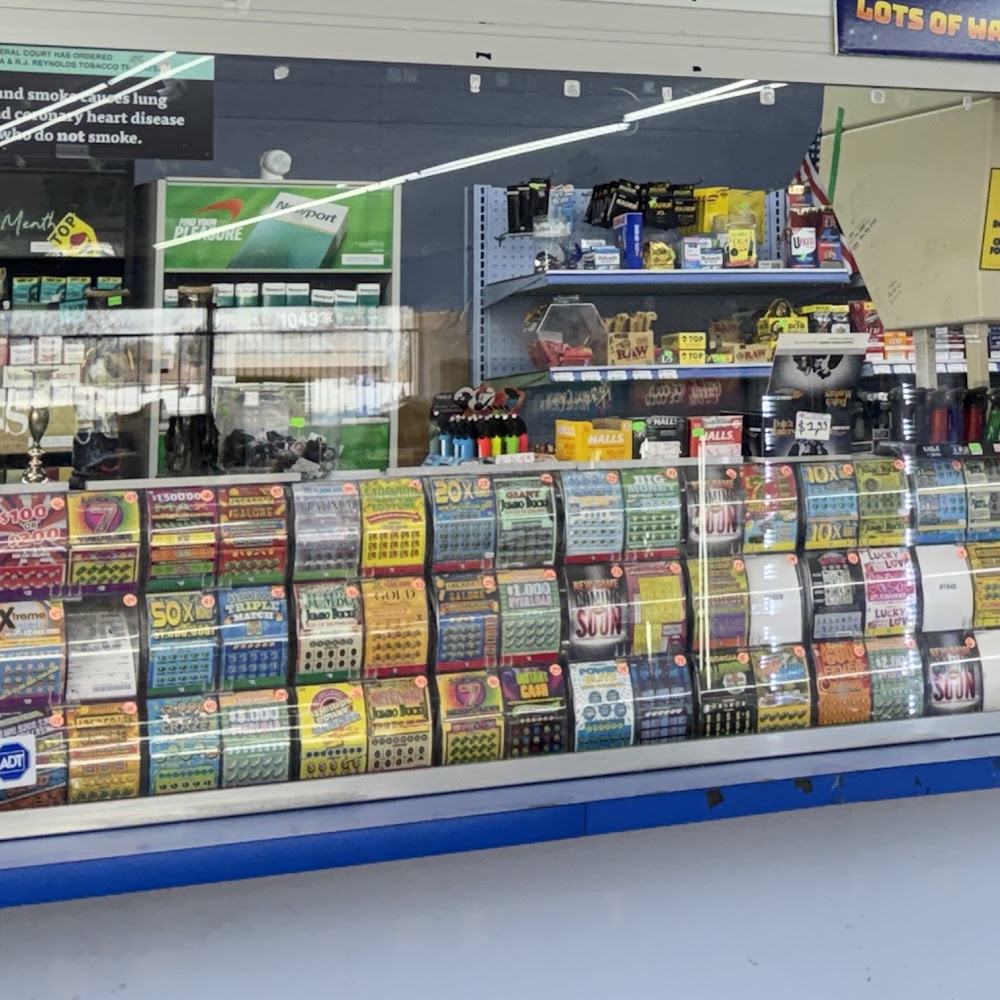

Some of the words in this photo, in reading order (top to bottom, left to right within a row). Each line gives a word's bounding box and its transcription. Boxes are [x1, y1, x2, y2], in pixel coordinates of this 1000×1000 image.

[929, 11, 963, 37] OF
[23, 49, 51, 58] COURT
[54, 51, 72, 59] HAS
[74, 52, 113, 61] ORDERED
[32, 59, 77, 68] REYNOLDS
[79, 61, 118, 70] TOBACCO
[133, 92, 168, 110] lung
[87, 110, 128, 124] heart
[131, 112, 185, 126] disease
[34, 128, 54, 141] do
[57, 130, 85, 142] not
[88, 130, 143, 145] smoke.
[50, 213, 77, 245] TOP
[197, 217, 217, 226] YOUR
[617, 345, 648, 360] RAW
[744, 350, 766, 359] RAW
[588, 433, 625, 444] HALLS
[633, 474, 666, 485] BIG
[806, 465, 839, 484] 10X
[627, 483, 675, 493] MONEY
[0, 507, 48, 525] $100
[88, 502, 118, 533] 7
[811, 522, 842, 542] 10X
[868, 550, 899, 562] LUCKY
[374, 589, 416, 601] GOLD
[151, 600, 195, 628] 50X
[225, 600, 280, 614] TRIPLE
[875, 608, 905, 619] LUCKY
[233, 611, 274, 622] MATCH
[575, 606, 622, 638] SOON
[521, 683, 549, 698] CASH
[933, 670, 976, 702] SOON
[458, 682, 480, 709] 7
[0, 756, 25, 770] ADT
